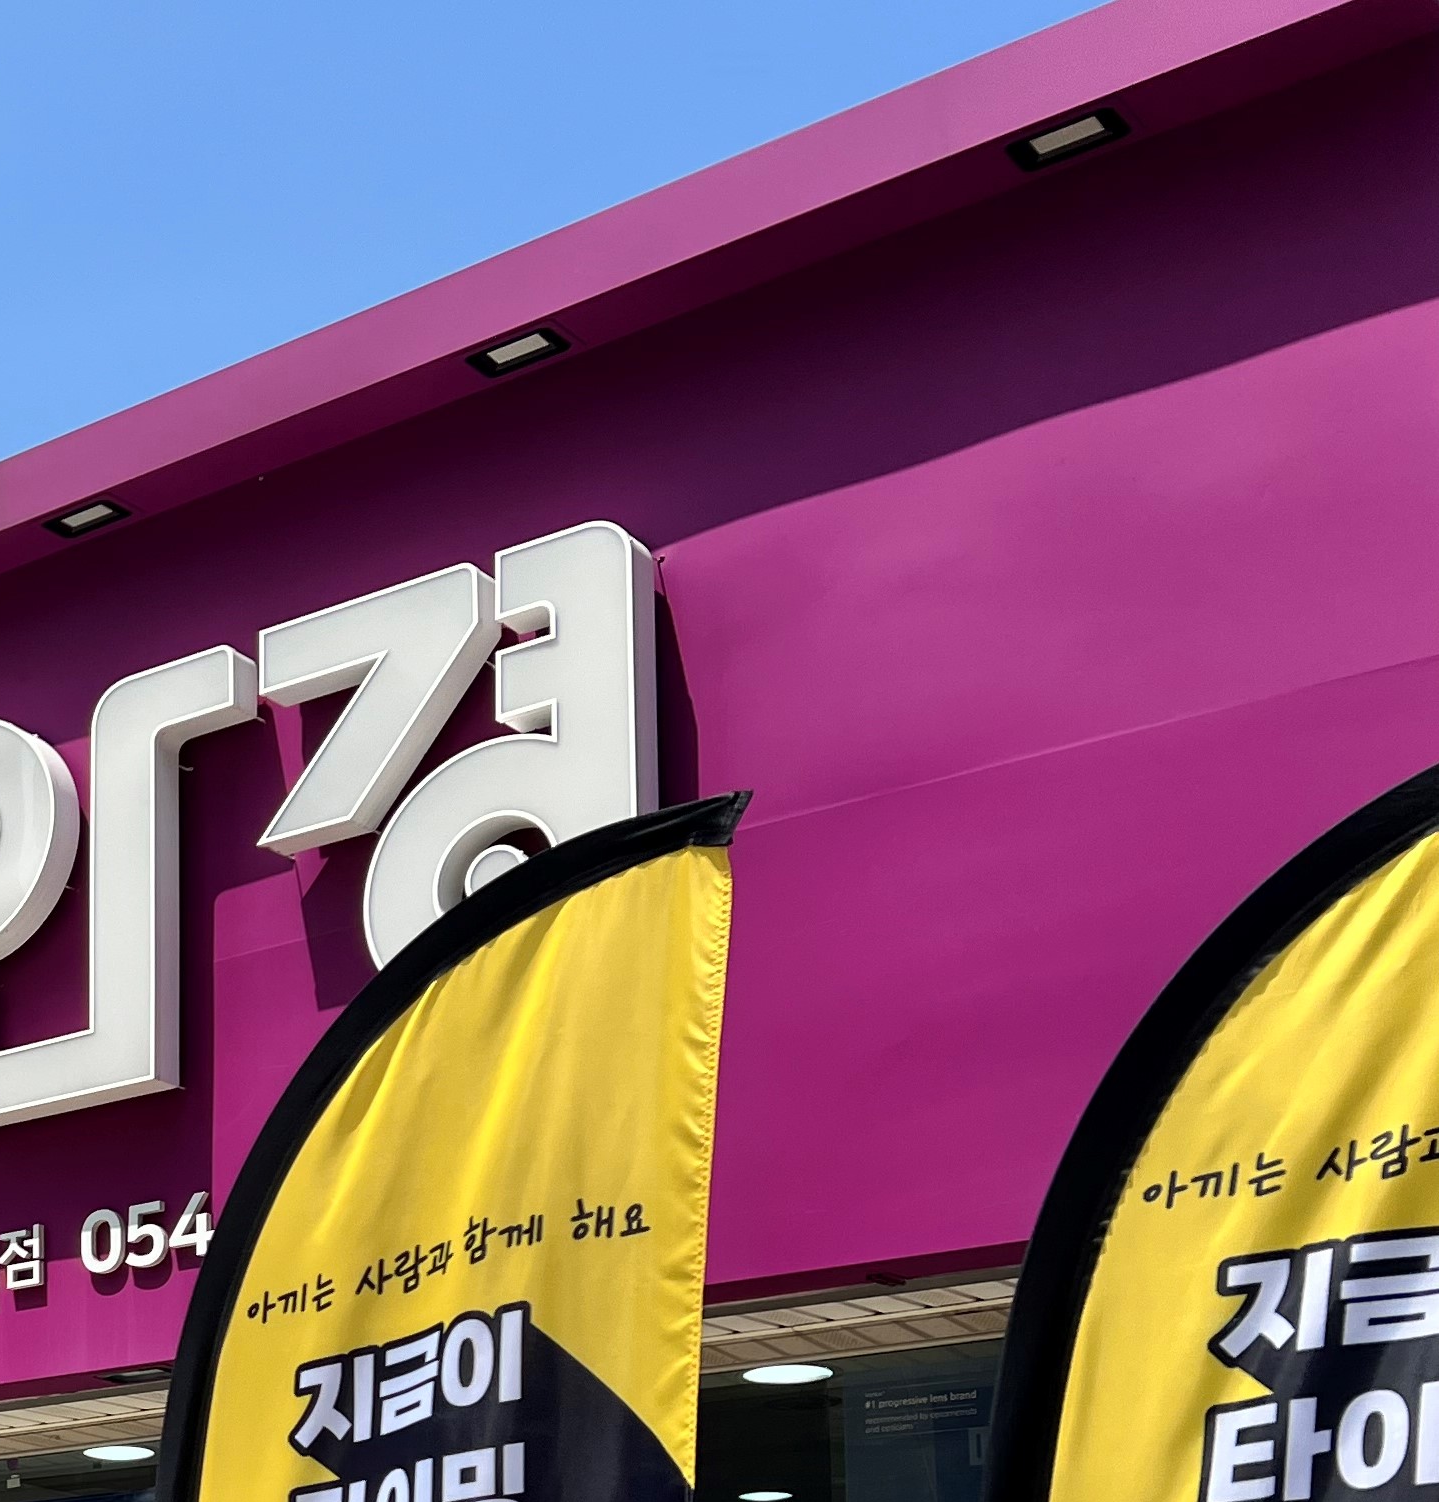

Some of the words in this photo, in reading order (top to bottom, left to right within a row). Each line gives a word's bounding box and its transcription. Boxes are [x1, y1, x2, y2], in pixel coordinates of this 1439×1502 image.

[1142, 1152, 1287, 1210] 아끼는
[80, 1192, 217, 1276] 054
[247, 1275, 335, 1324] 아끼는
[355, 1240, 454, 1296] 사람과
[462, 1214, 543, 1266] 함께
[570, 1200, 650, 1241] 해요
[292, 1308, 525, 1449] 지금이
[949, 1389, 977, 1401] brand
